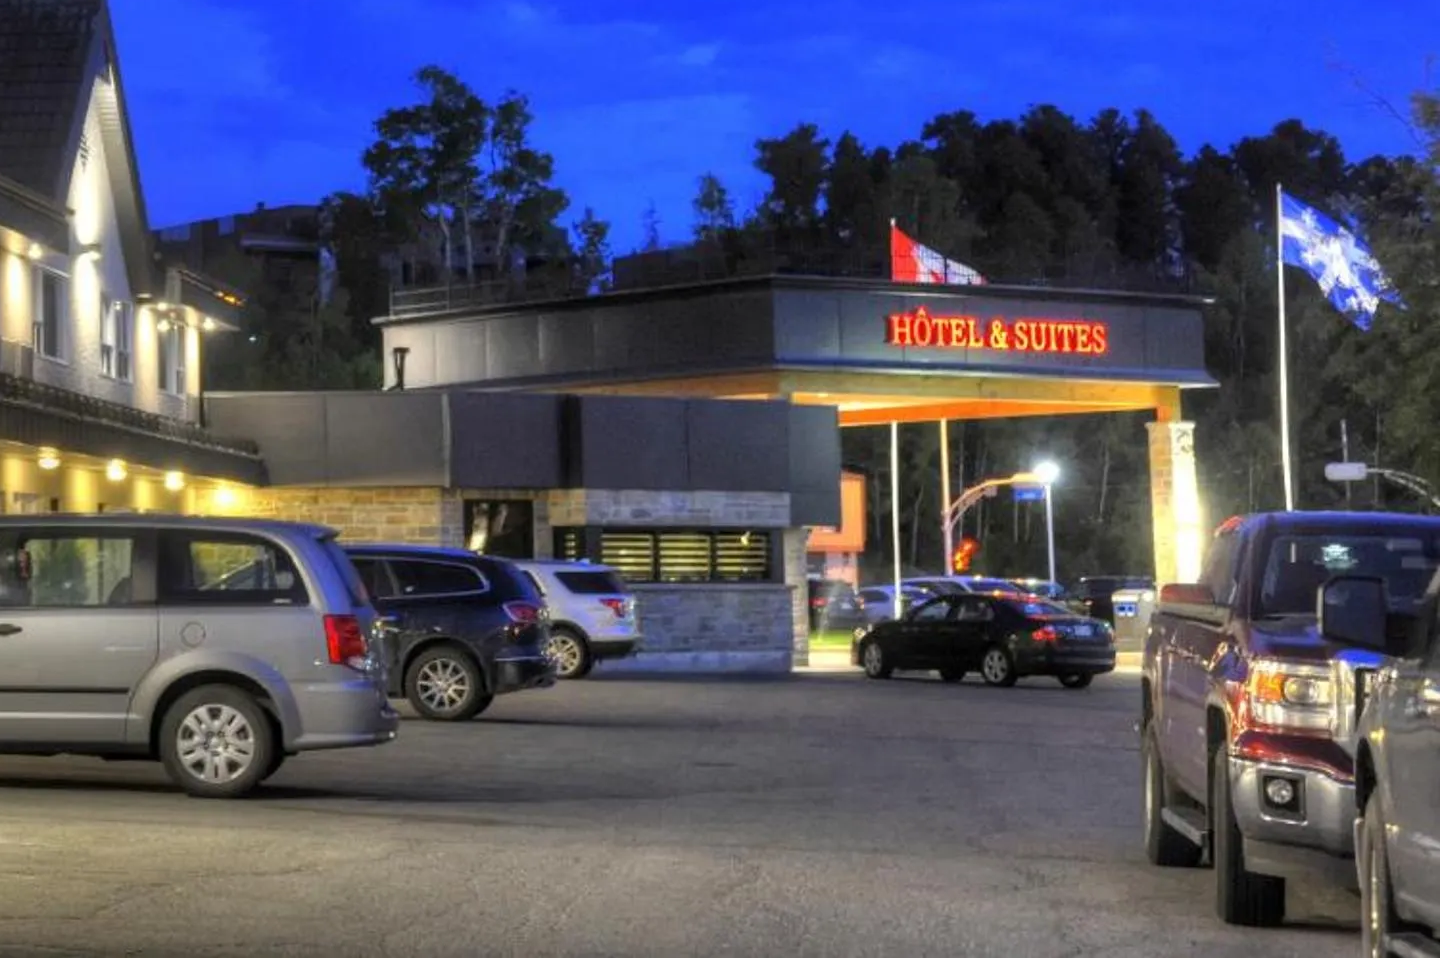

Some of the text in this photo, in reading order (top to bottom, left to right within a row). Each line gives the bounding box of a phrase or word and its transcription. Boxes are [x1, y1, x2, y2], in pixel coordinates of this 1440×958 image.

[890, 306, 1107, 354] HÔTEL & SUITES
